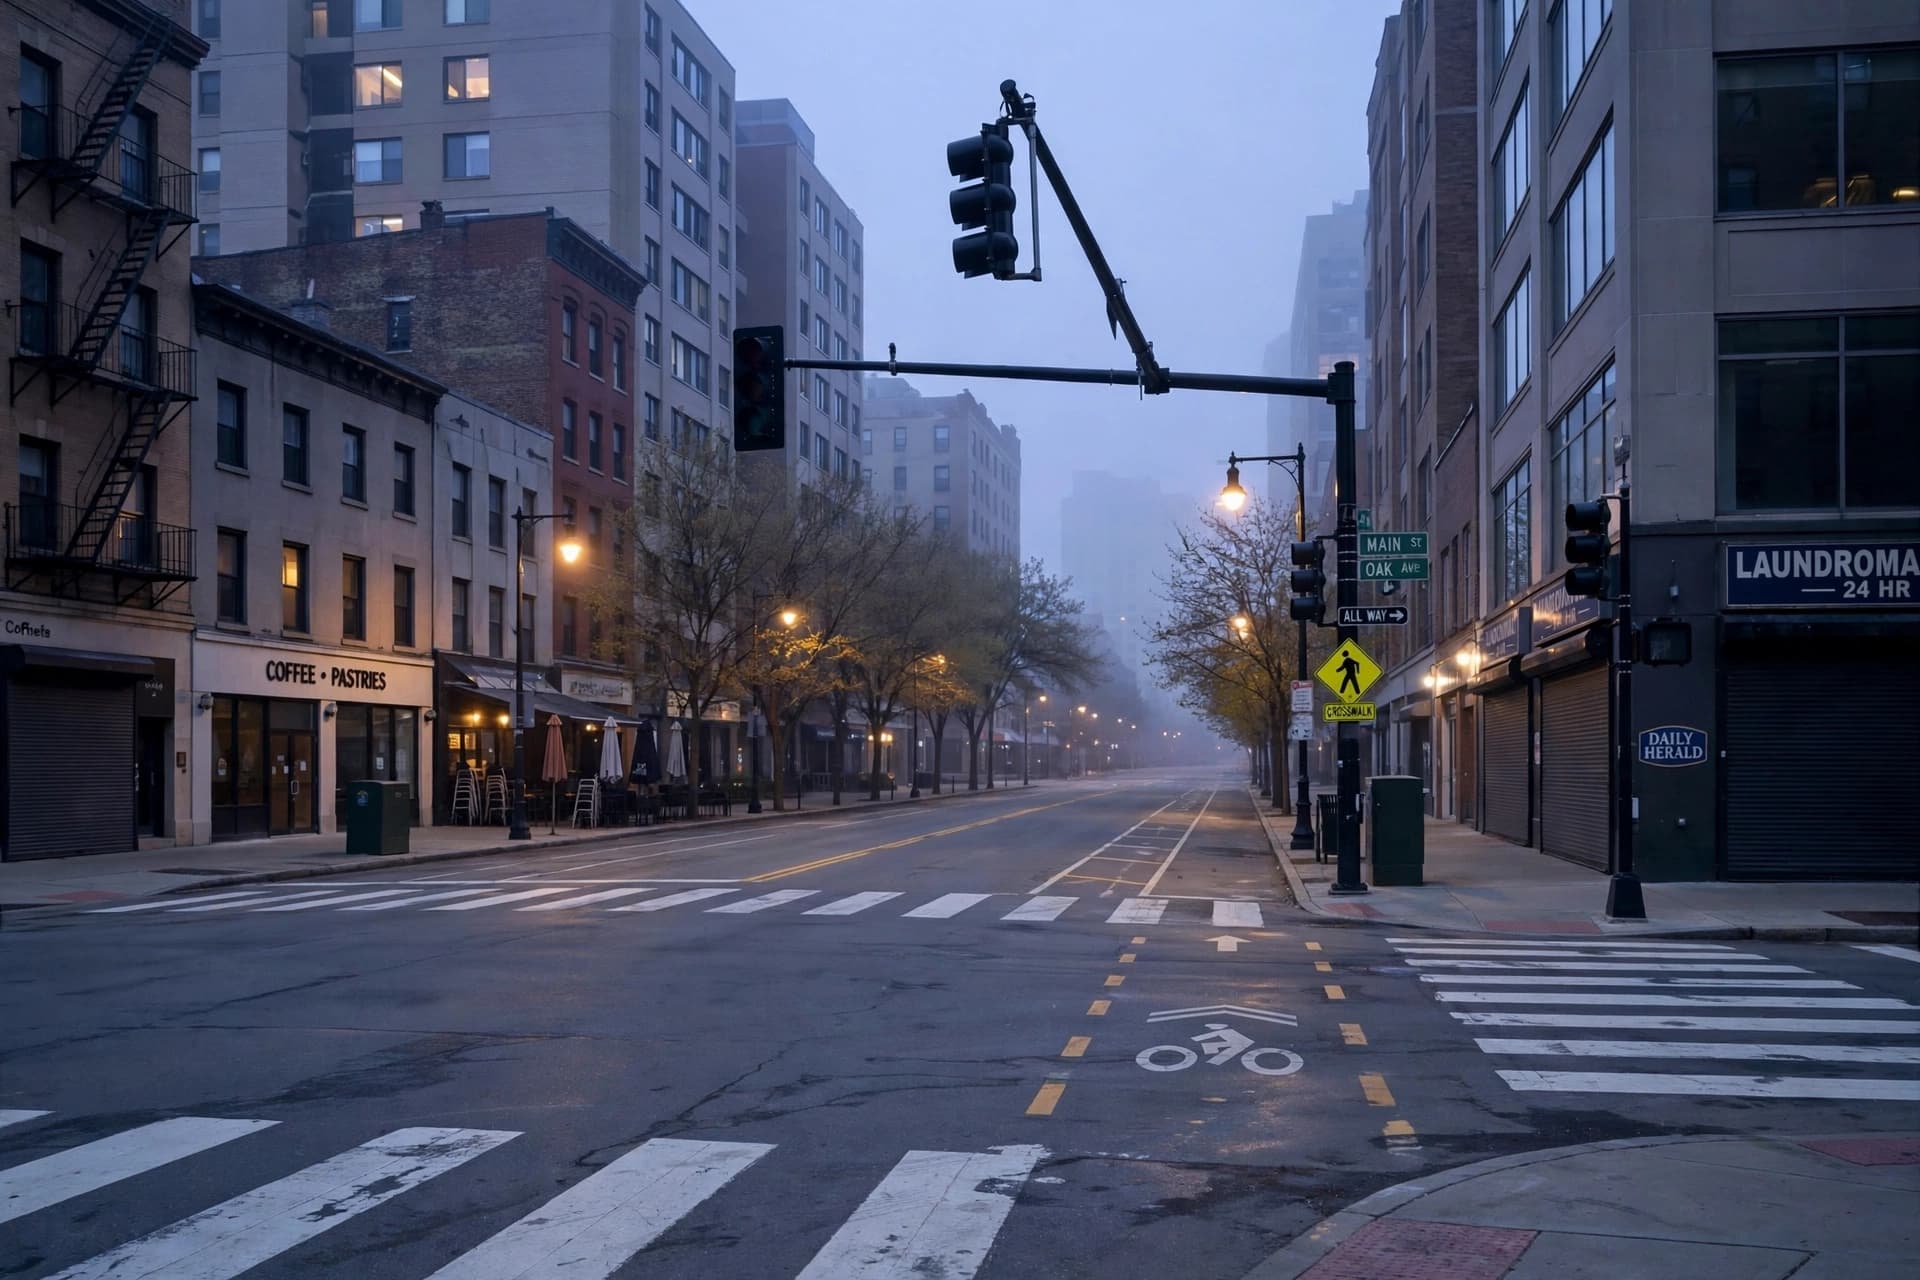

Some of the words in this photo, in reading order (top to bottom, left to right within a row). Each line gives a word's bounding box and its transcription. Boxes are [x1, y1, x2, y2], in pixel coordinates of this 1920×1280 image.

[1367, 537, 1401, 552] MAIN
[1365, 562, 1393, 577] OAK
[1401, 562, 1421, 574] AVE
[1736, 549, 1920, 579] LAUNDROMA
[1843, 580, 1870, 598] 24
[1879, 580, 1911, 598] HR
[1343, 609, 1363, 622] ALL
[1366, 609, 1387, 622] WAY
[266, 660, 316, 685] COFFEE
[331, 667, 386, 691] PASTRIES
[1648, 731, 1693, 746] DAILY
[1644, 746, 1703, 760] HERALD
